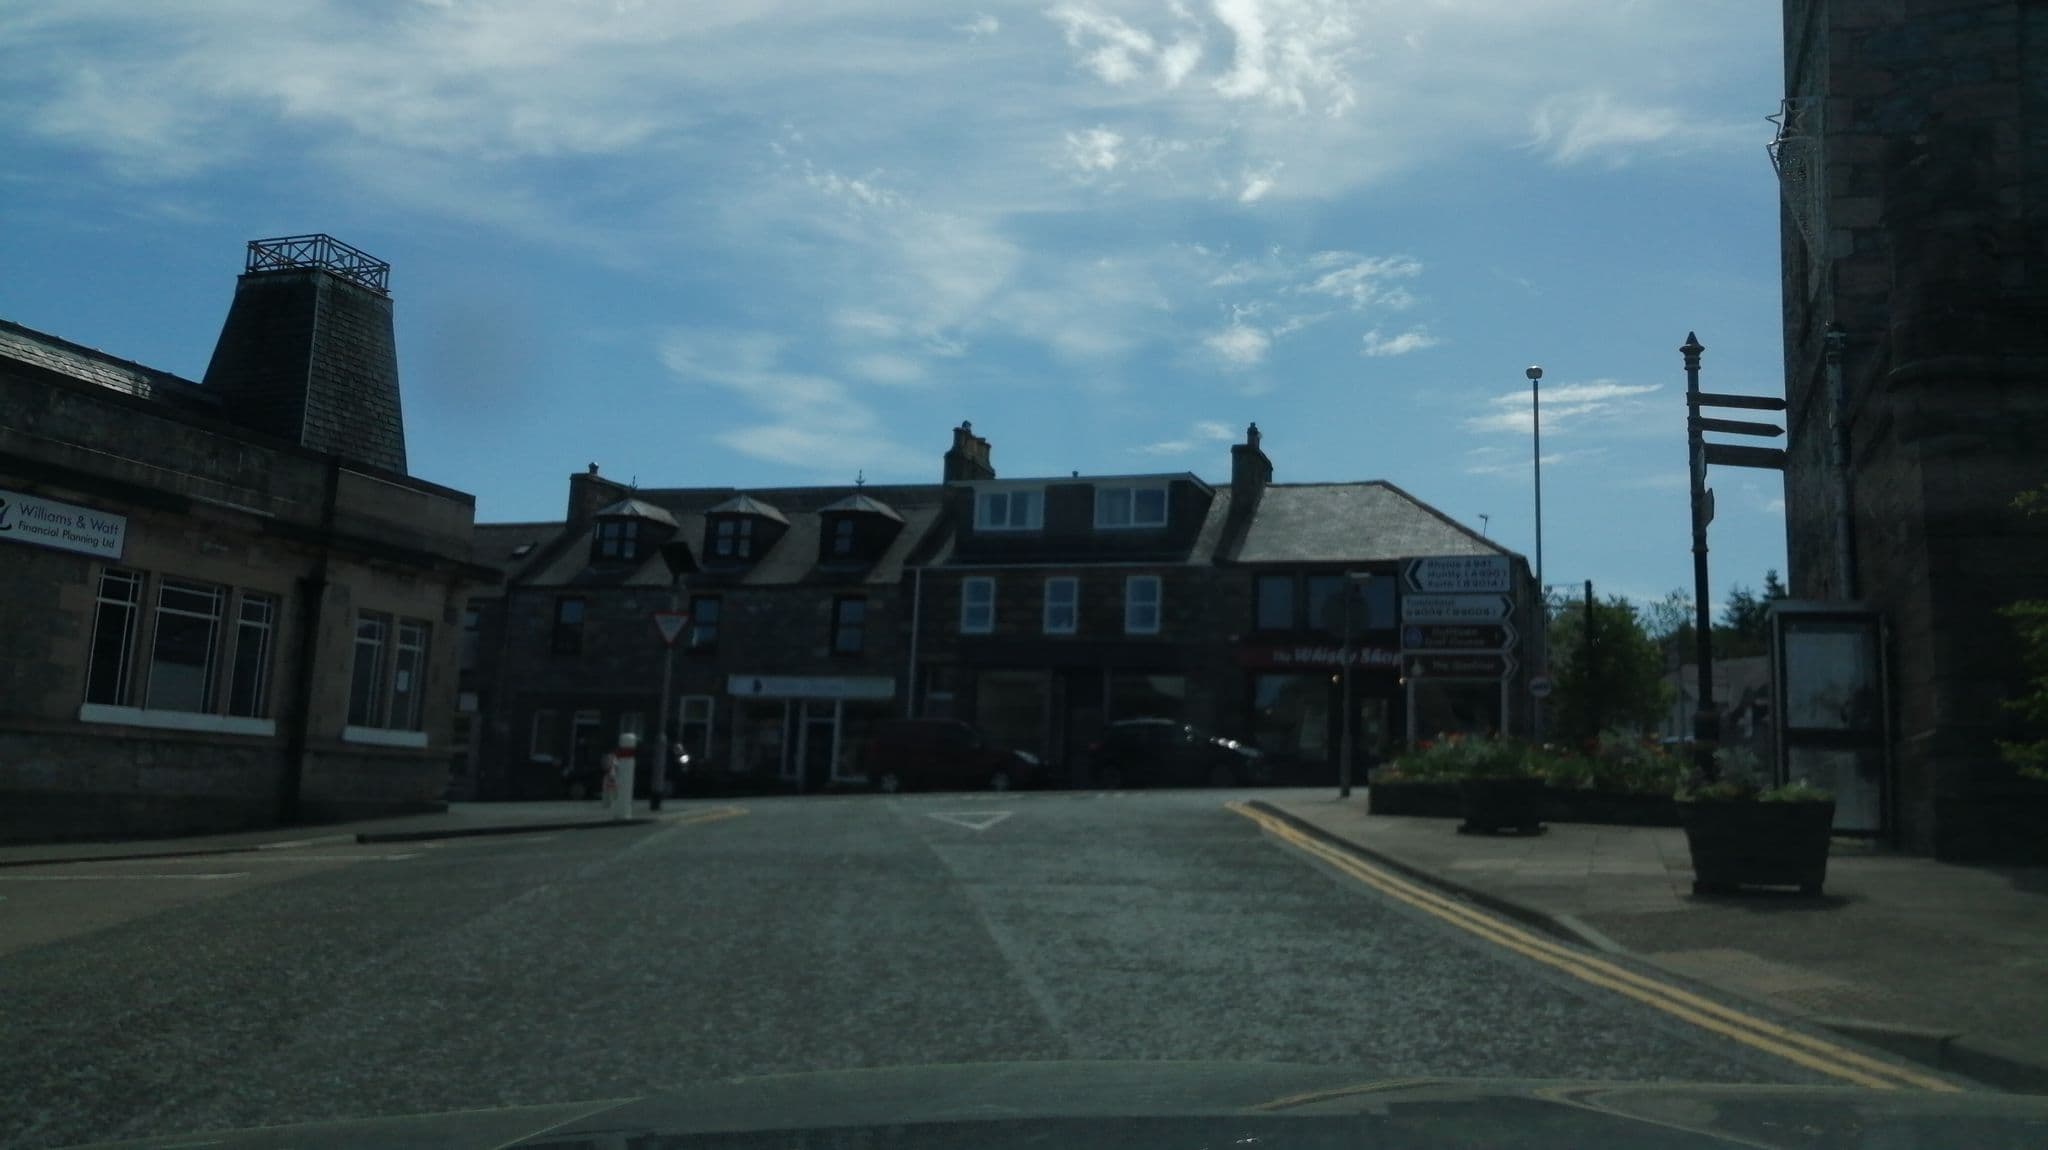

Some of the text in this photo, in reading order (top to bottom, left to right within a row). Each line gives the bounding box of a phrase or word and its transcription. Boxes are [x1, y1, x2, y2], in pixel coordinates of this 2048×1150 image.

[18, 520, 115, 549] Financial Planning Ltd
[19, 504, 119, 536] Williams & Watt
